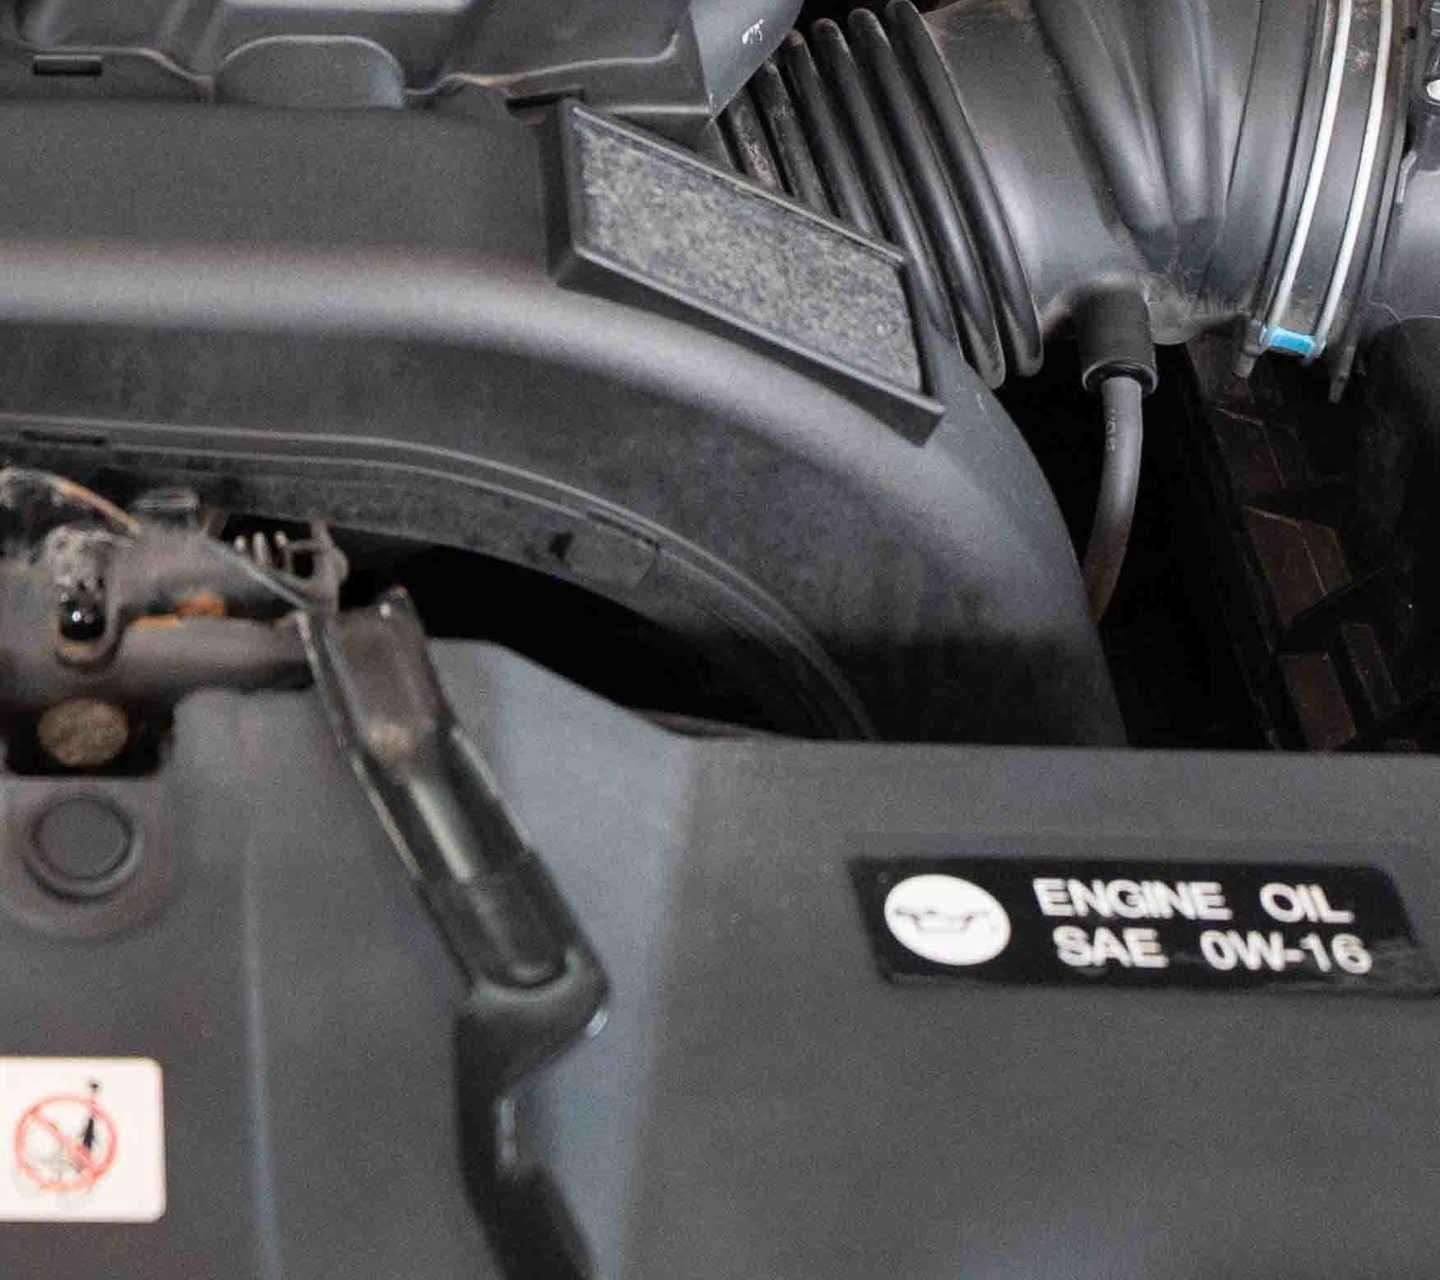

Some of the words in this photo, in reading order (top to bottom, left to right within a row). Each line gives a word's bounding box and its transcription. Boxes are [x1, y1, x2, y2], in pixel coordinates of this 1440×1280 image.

[1032, 877, 1232, 920] ENGINE
[1259, 881, 1355, 925] OIL
[1054, 926, 1168, 969] SAE
[1200, 932, 1373, 975] 0W-16
